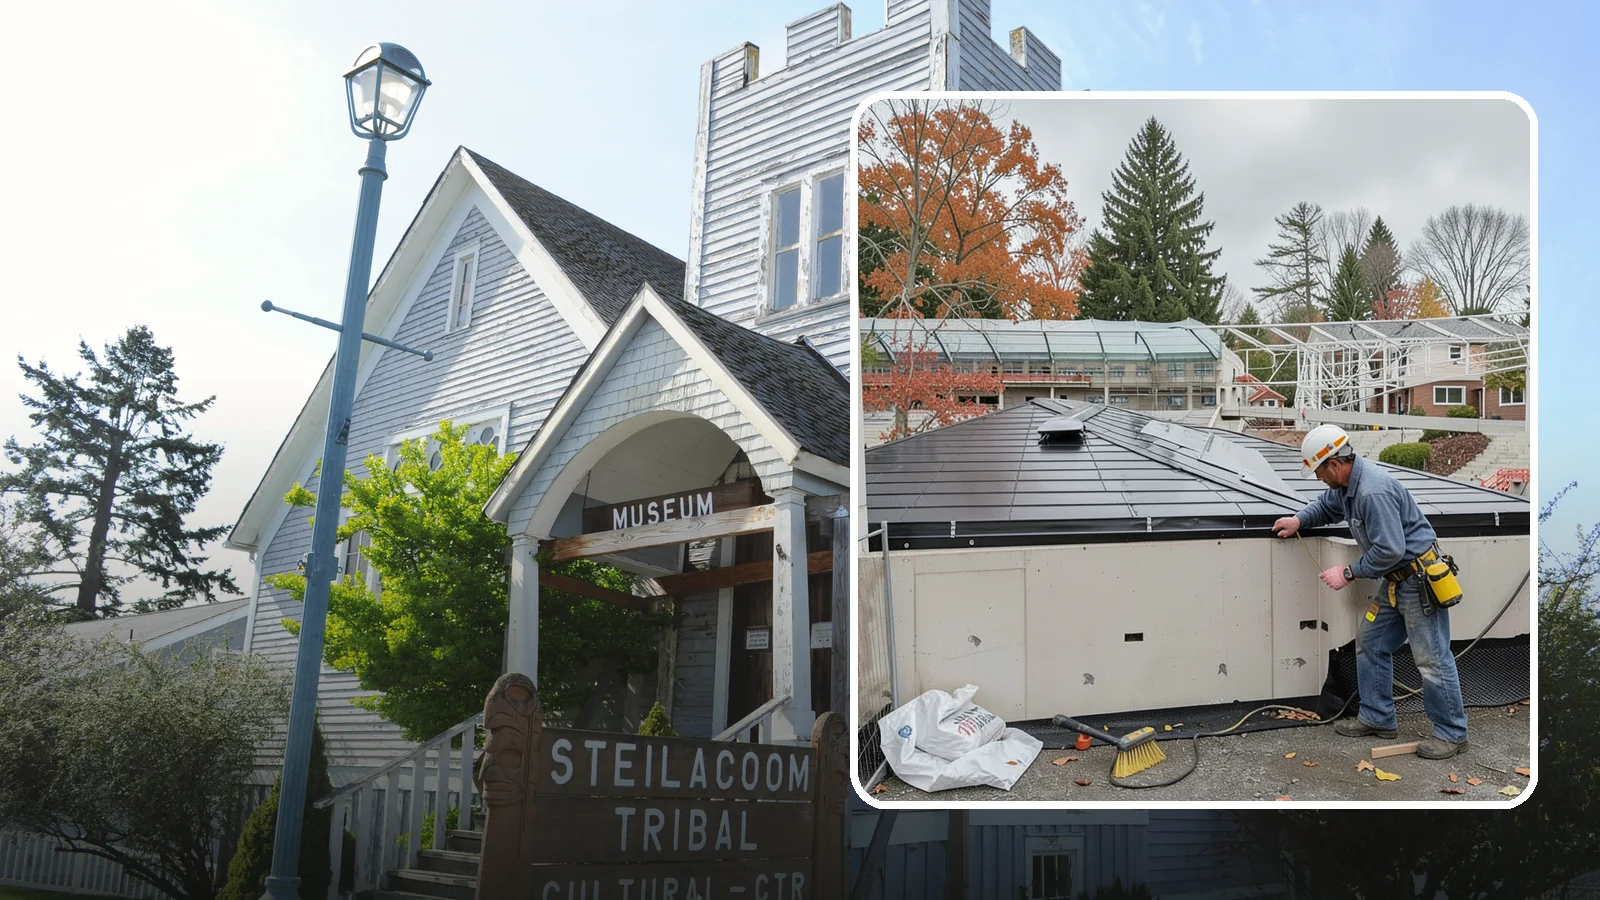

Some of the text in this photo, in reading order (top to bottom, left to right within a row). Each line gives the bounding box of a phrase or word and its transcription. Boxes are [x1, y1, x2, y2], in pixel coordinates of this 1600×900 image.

[613, 491, 713, 530] MUSEUM
[551, 738, 809, 792] STEILACOOM
[615, 807, 757, 851] TRIBAL
